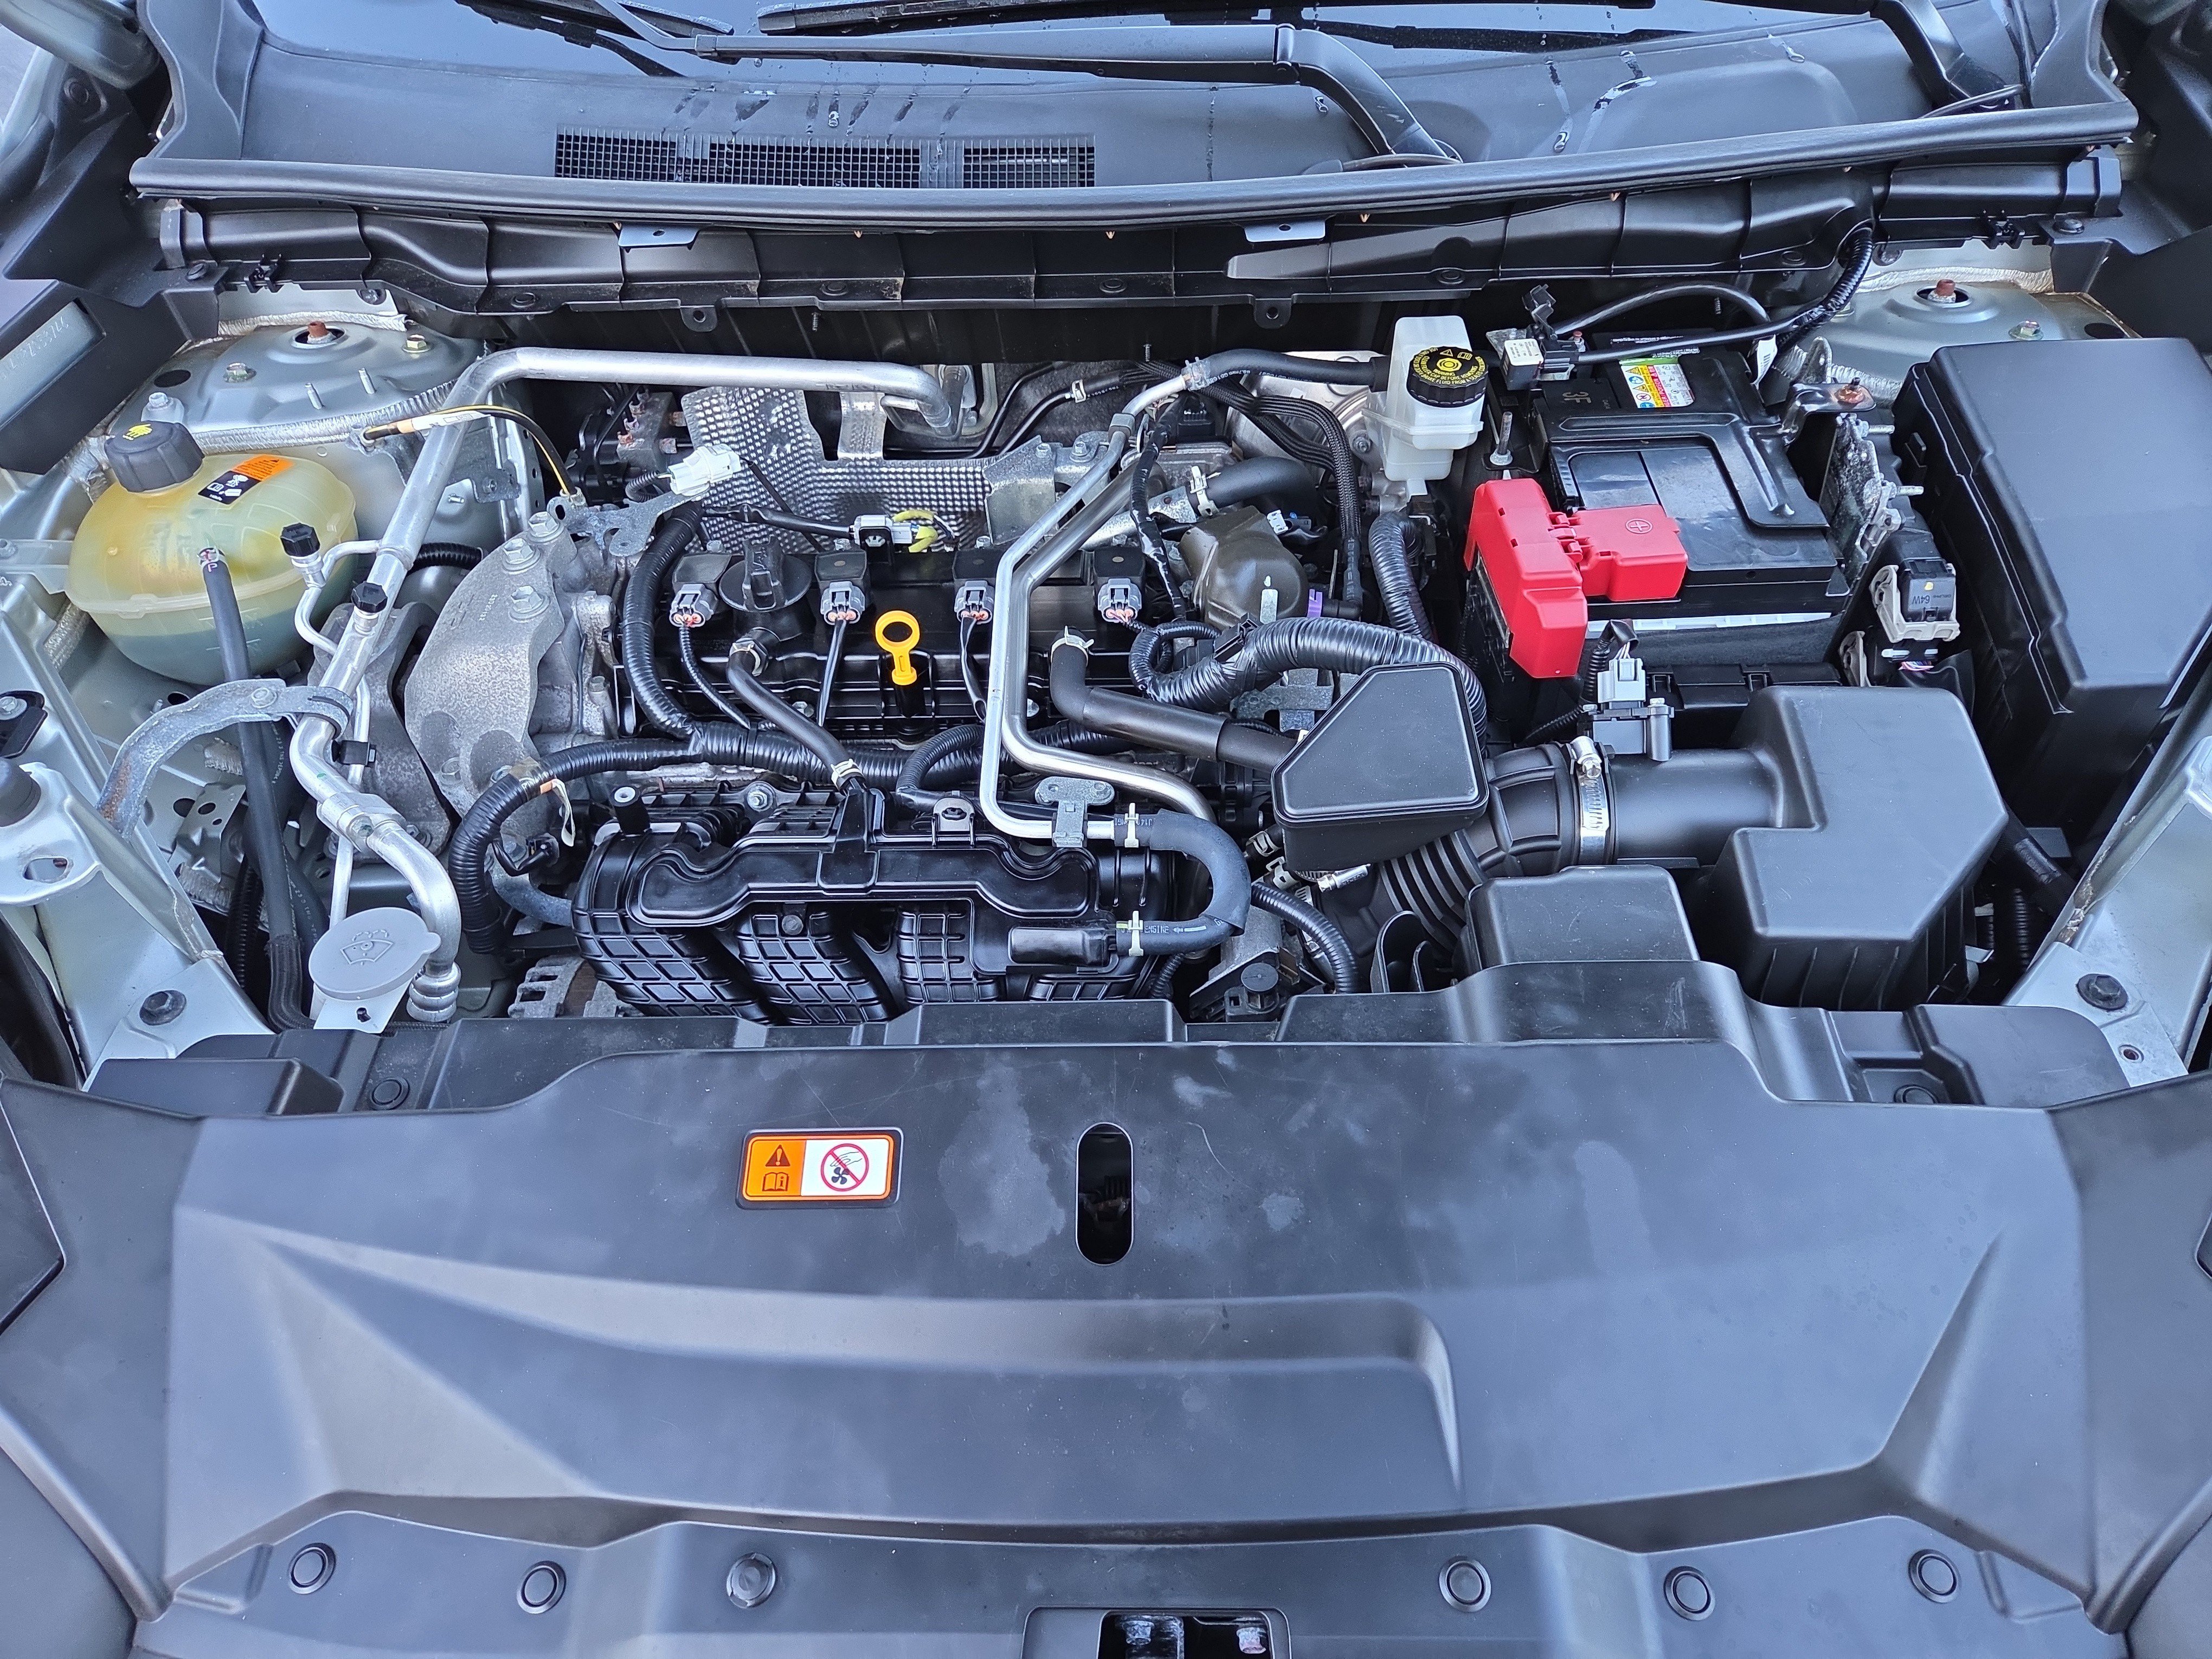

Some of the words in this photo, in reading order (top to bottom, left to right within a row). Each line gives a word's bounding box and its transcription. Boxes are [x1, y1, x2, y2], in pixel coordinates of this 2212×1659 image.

[1562, 391, 1592, 404] 3F
[1912, 595, 1931, 605] 64W
[1144, 925, 1169, 934] ENGINE
